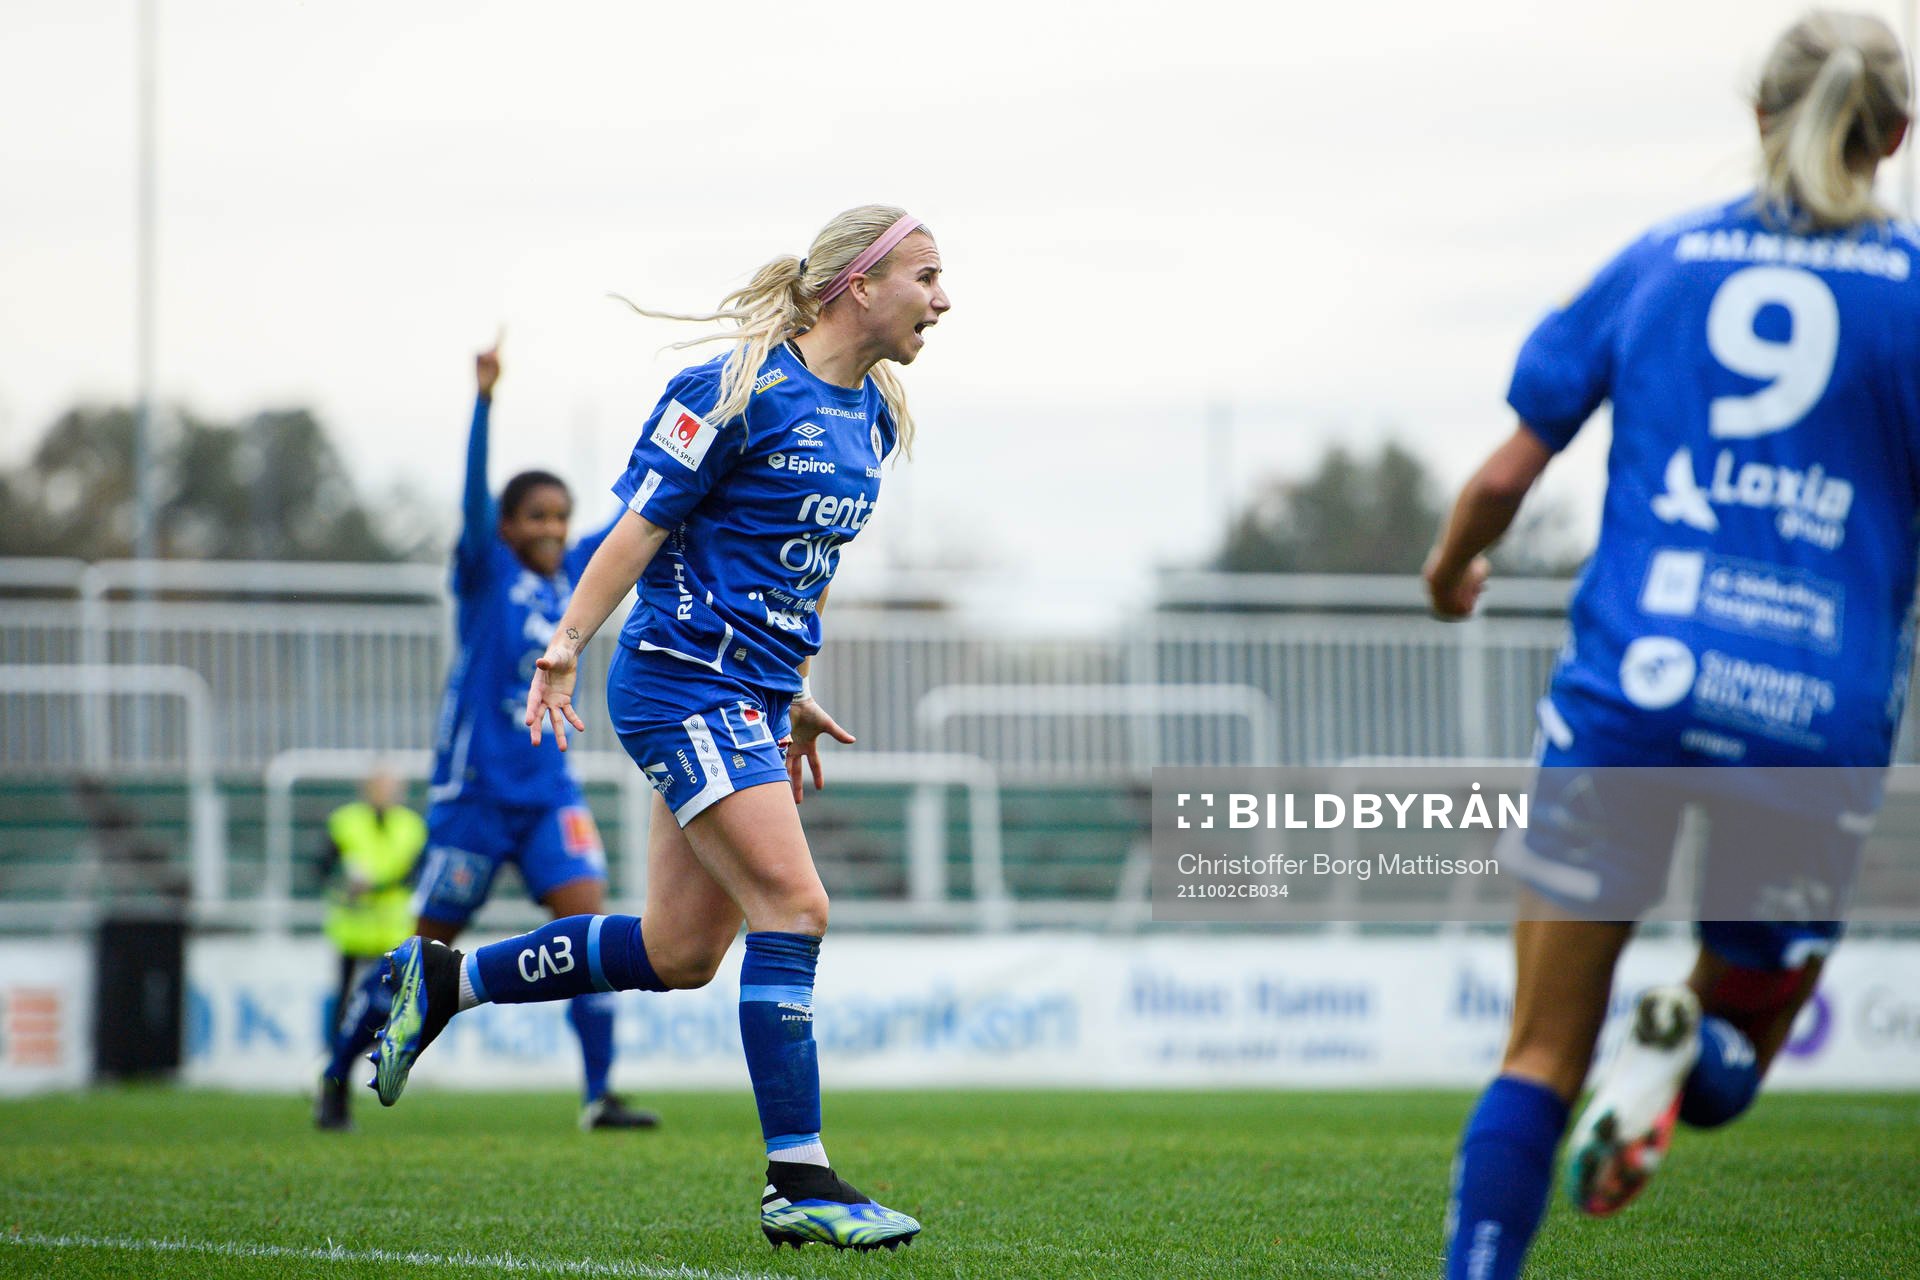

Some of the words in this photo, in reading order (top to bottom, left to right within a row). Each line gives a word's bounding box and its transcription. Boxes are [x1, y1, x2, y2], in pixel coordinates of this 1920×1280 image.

[1706, 264, 1841, 440] 9
[655, 432, 679, 455] SVENSKA
[680, 451, 696, 467] SPEL
[797, 438, 824, 448] umbro
[788, 455, 836, 475] Epiroc
[676, 748, 698, 784] umbro
